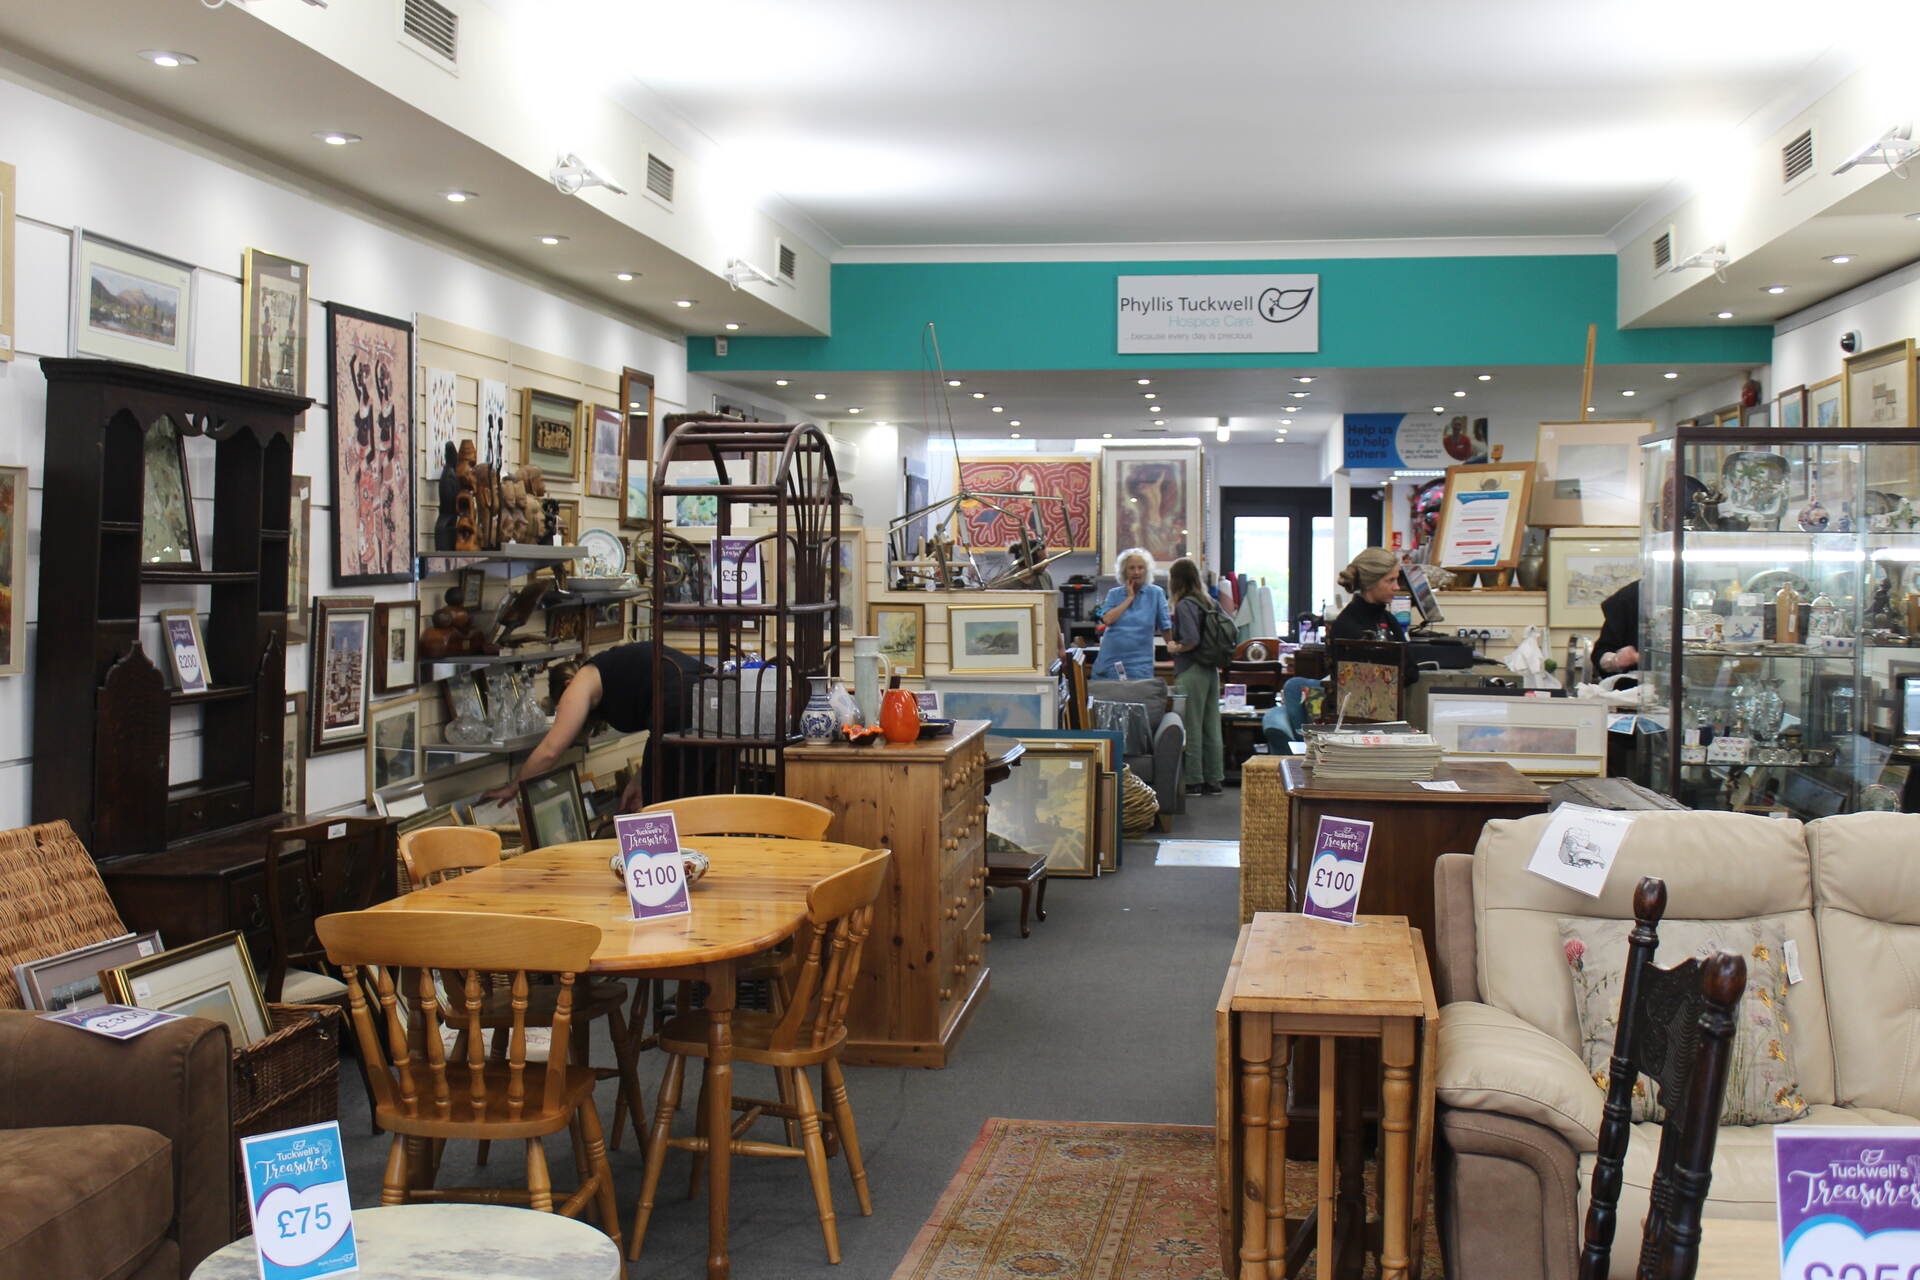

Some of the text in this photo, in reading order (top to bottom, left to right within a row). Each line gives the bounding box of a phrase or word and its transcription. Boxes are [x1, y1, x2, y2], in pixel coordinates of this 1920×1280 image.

[1120, 296, 1253, 315] Phyllis Tuckwell
[1169, 315, 1253, 330] Hospice Care
[1168, 333, 1189, 342] every
[1192, 332, 1206, 341] day
[1208, 332, 1215, 340] is
[1217, 332, 1253, 341] precious
[1347, 424, 1376, 436] Help
[1379, 425, 1393, 435] us
[1348, 436, 1389, 448] to help
[1348, 449, 1387, 459] others
[722, 569, 748, 582] £50
[623, 833, 668, 851] Treasures
[1321, 832, 1360, 852] Treasures
[633, 865, 677, 888] £100
[1314, 868, 1355, 892] £100
[276, 1146, 321, 1162] Tuckwell's
[254, 1155, 329, 1186] Treasures
[1829, 1163, 1909, 1179] Tuckwell's
[1787, 1169, 1920, 1213] Treasures
[277, 1202, 332, 1239] £75
